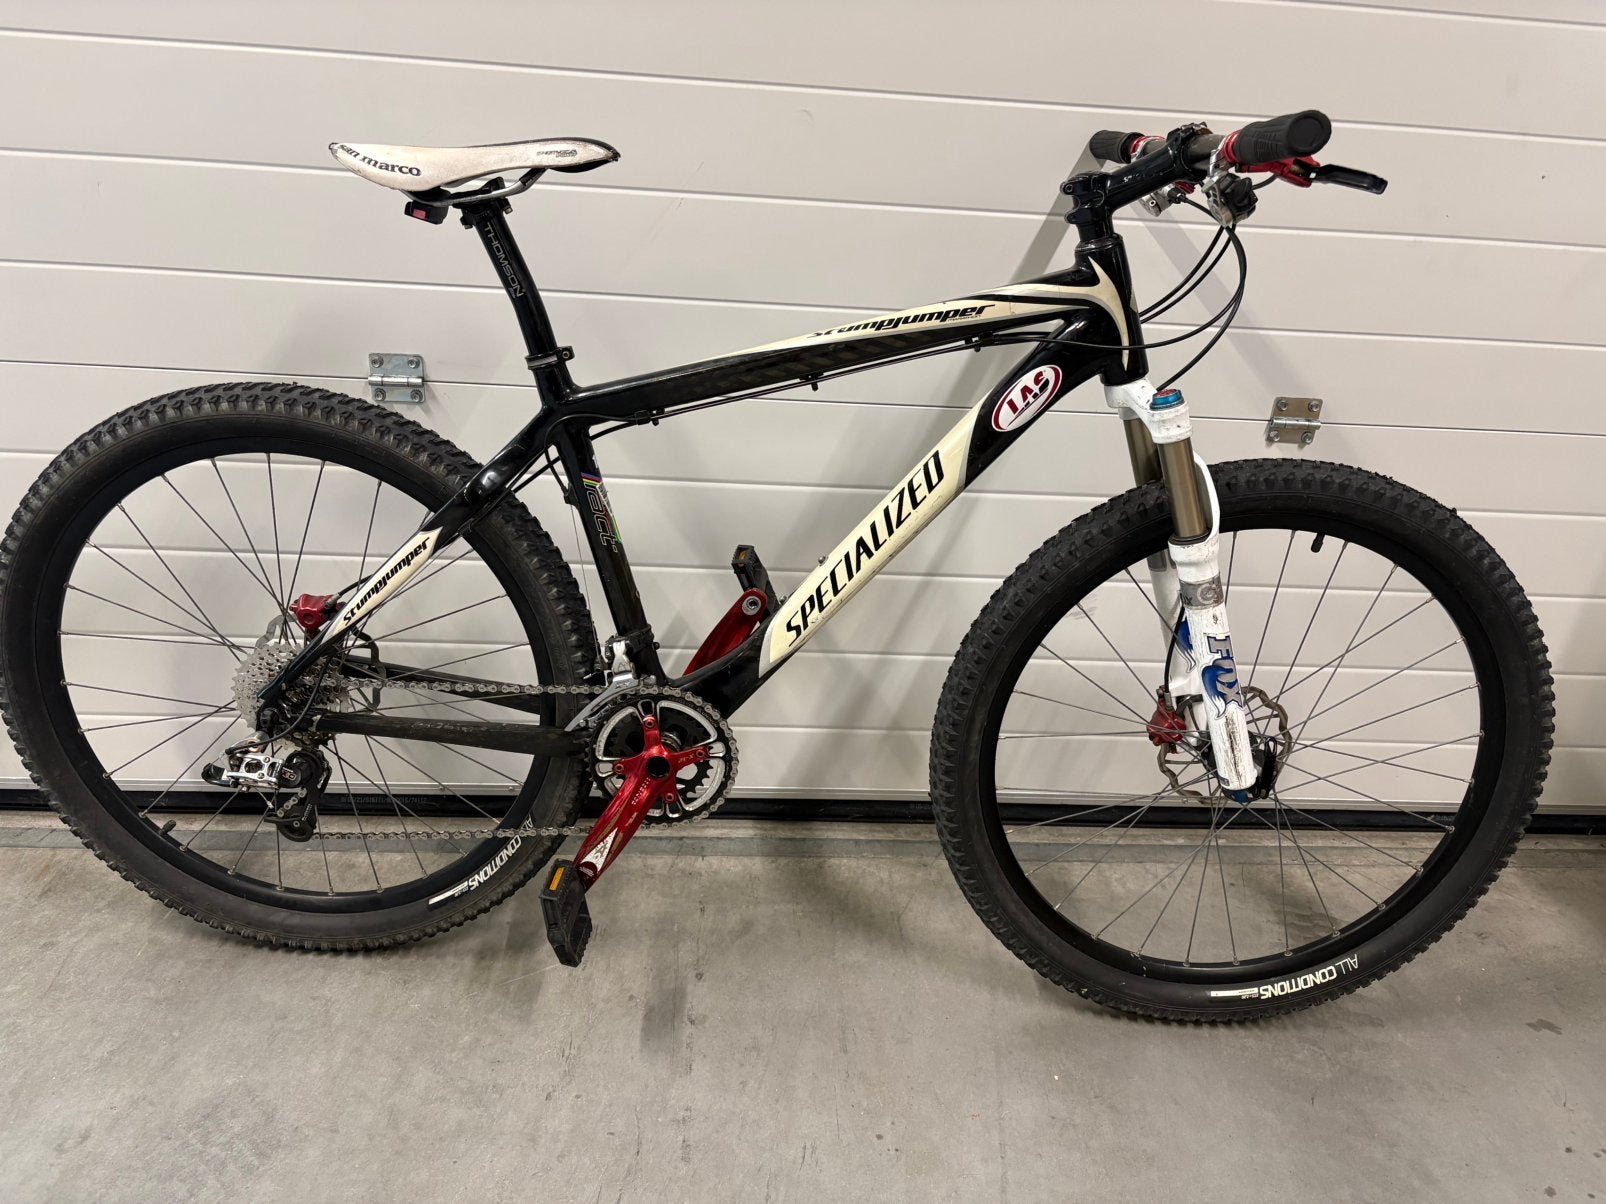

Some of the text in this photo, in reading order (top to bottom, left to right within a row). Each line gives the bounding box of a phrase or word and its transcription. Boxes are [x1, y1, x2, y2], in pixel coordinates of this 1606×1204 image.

[360, 155, 422, 177] marco
[484, 221, 525, 298] THOMSON
[786, 449, 945, 648] SPECIALIZED
[1206, 634, 1244, 710] FOX
[467, 834, 522, 891] CONDITIONS
[1259, 953, 1360, 1000] ALL CONDITIONS
